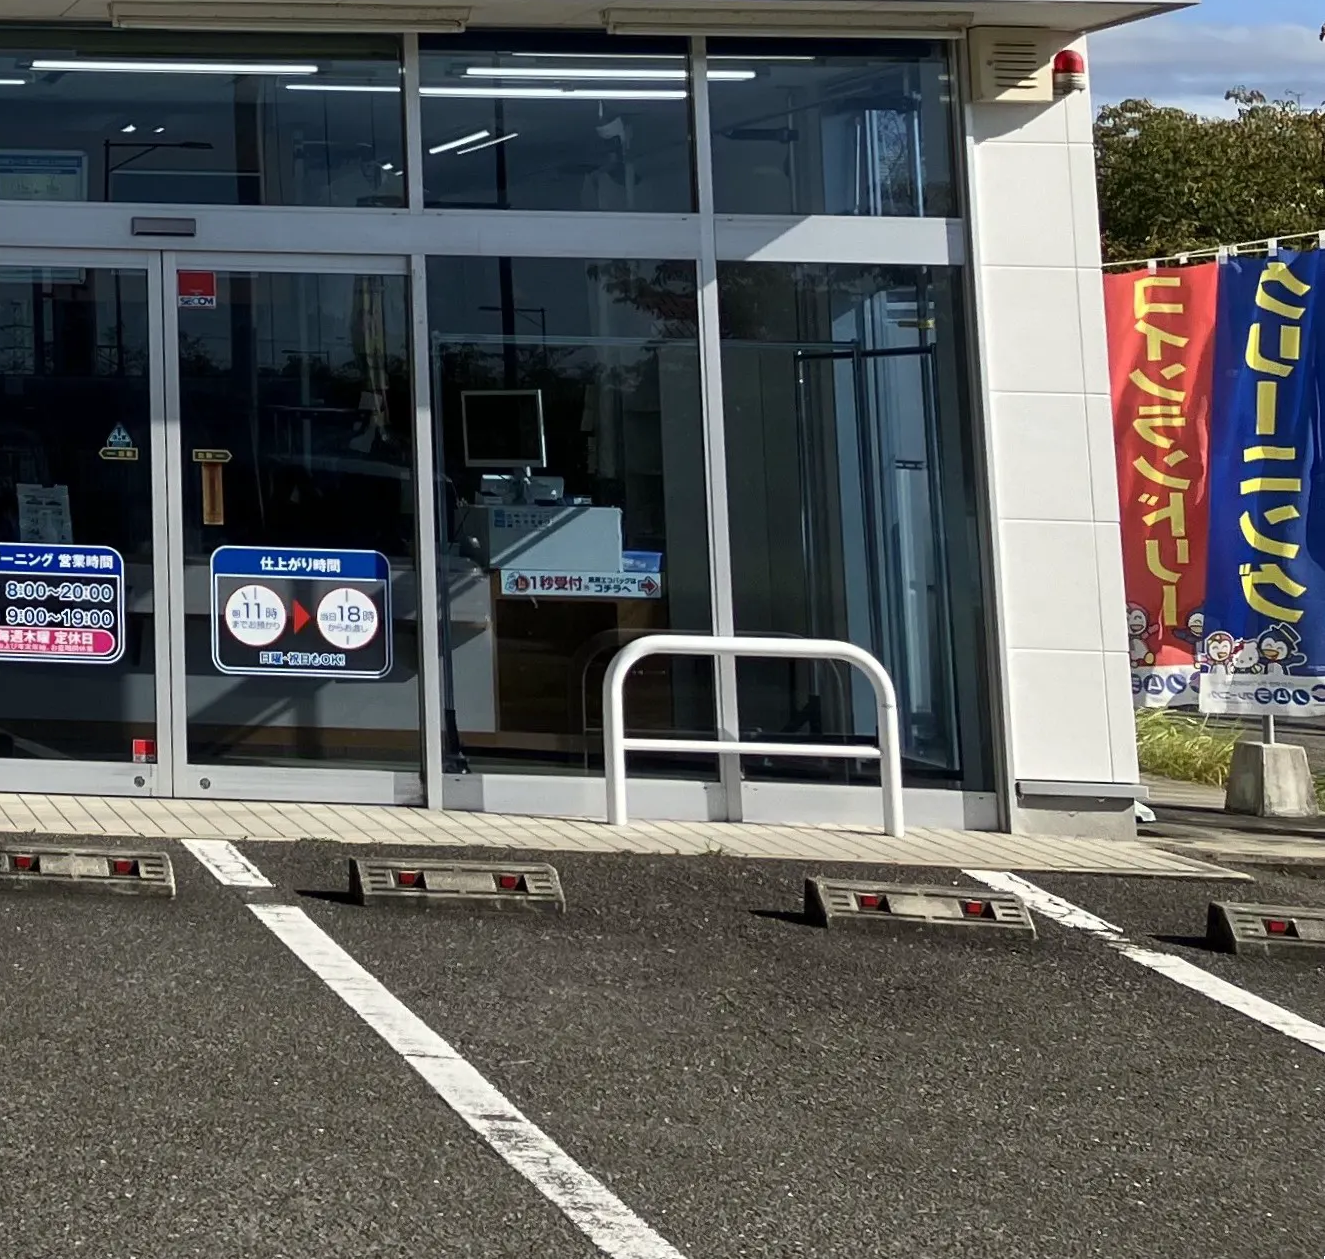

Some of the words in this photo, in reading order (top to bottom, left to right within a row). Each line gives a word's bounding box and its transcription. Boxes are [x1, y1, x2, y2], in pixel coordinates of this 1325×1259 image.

[180, 297, 214, 306] SECOM
[58, 553, 114, 570] 営業時間
[259, 556, 341, 573] 仕上がり時間
[54, 631, 94, 645] 定休日
